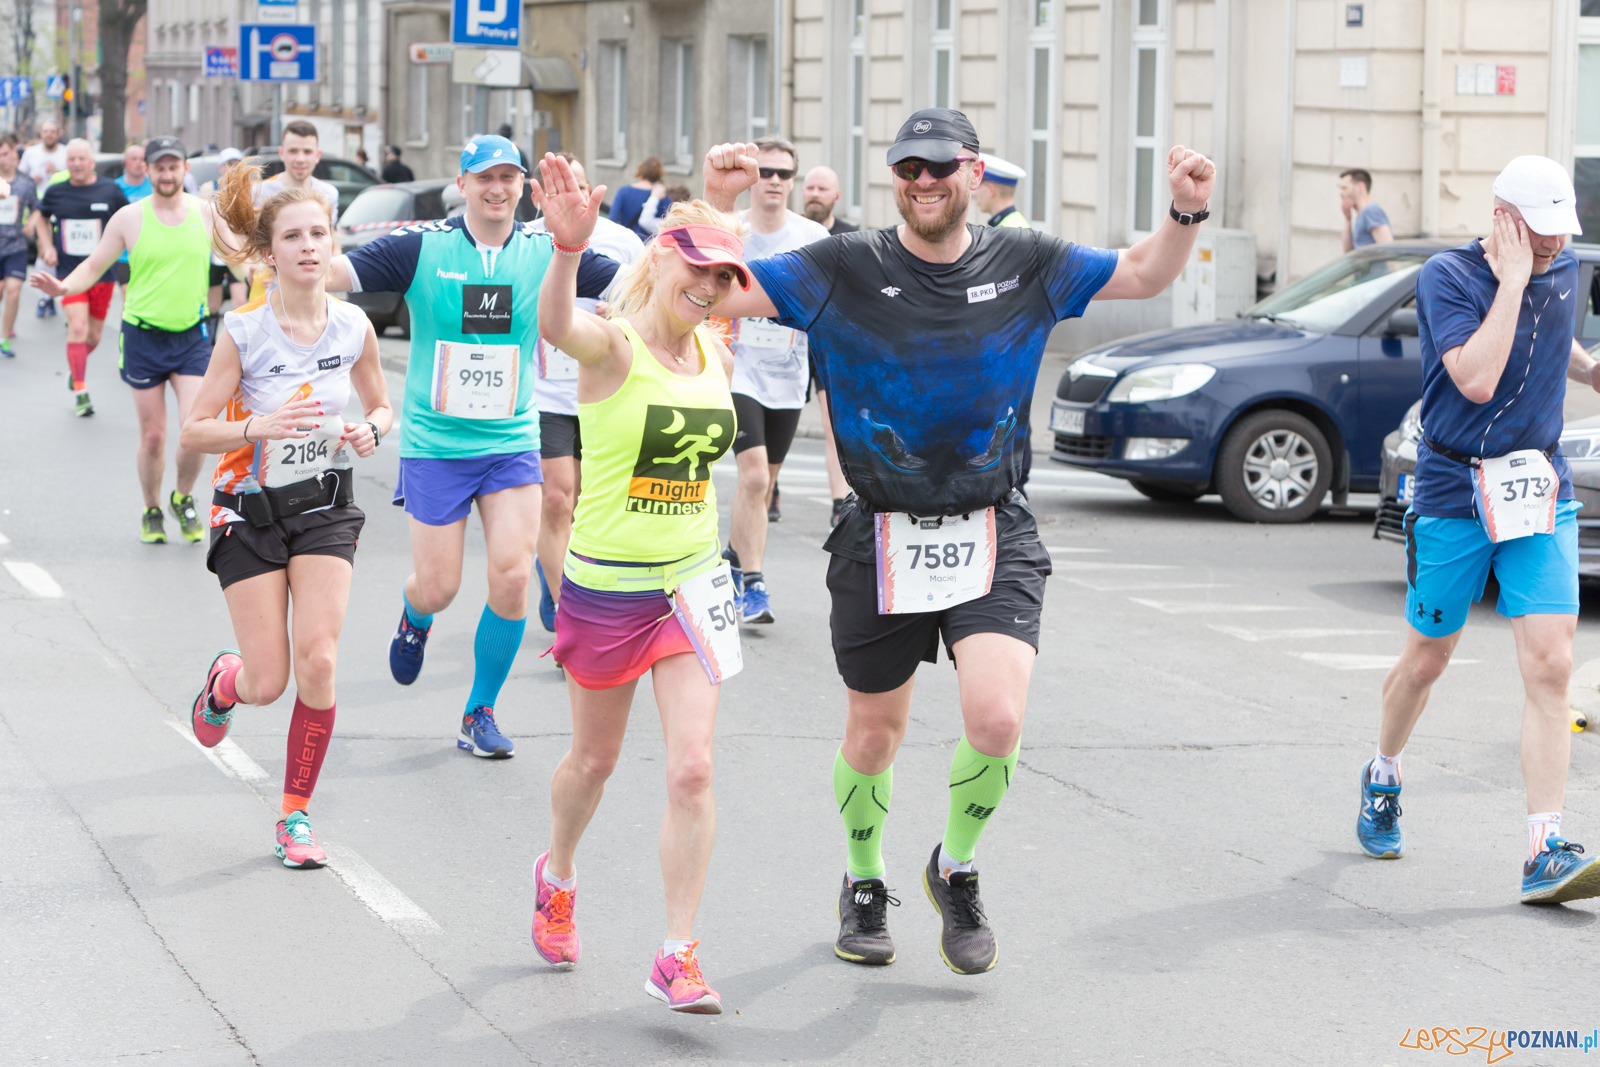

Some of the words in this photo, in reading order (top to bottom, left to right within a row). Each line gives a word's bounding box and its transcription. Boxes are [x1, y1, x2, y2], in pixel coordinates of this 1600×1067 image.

[466, 0, 507, 36] P
[436, 267, 468, 281] hummel
[479, 292, 499, 311] M
[269, 364, 286, 374] 4F
[459, 368, 503, 388] 9915
[472, 390, 489, 398] Maciej
[281, 439, 328, 465] 2184
[294, 466, 320, 476] Karolina
[650, 480, 701, 501] night
[1500, 477, 1551, 502] 3732
[906, 541, 976, 570] 7587
[929, 574, 957, 583] Maciej
